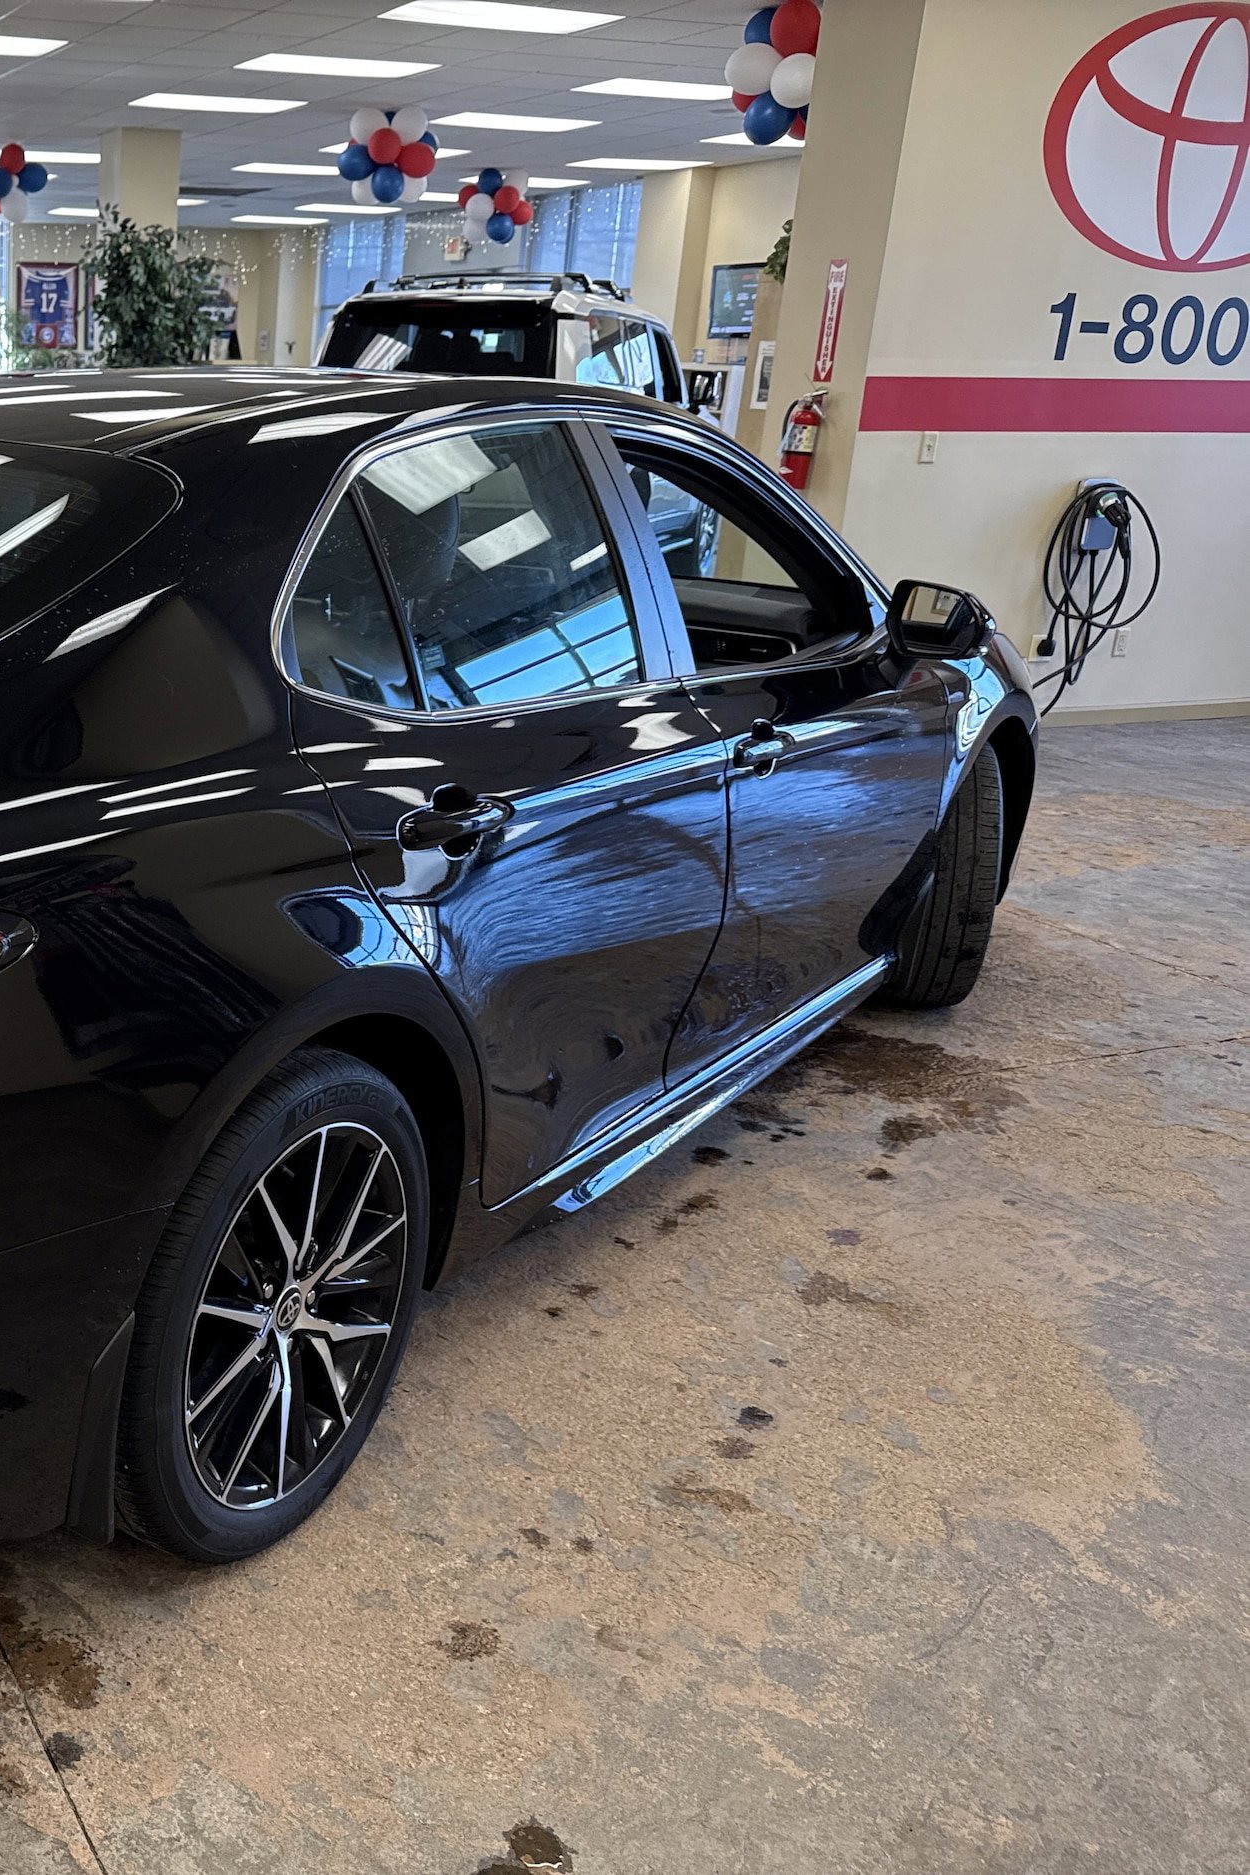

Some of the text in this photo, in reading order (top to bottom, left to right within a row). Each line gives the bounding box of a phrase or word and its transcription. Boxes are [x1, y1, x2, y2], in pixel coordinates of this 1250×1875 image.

[830, 270, 845, 283] FIRE
[40, 292, 58, 314] 17
[820, 286, 838, 373] EXTINGUISHER
[1050, 292, 1250, 366] 1-800
